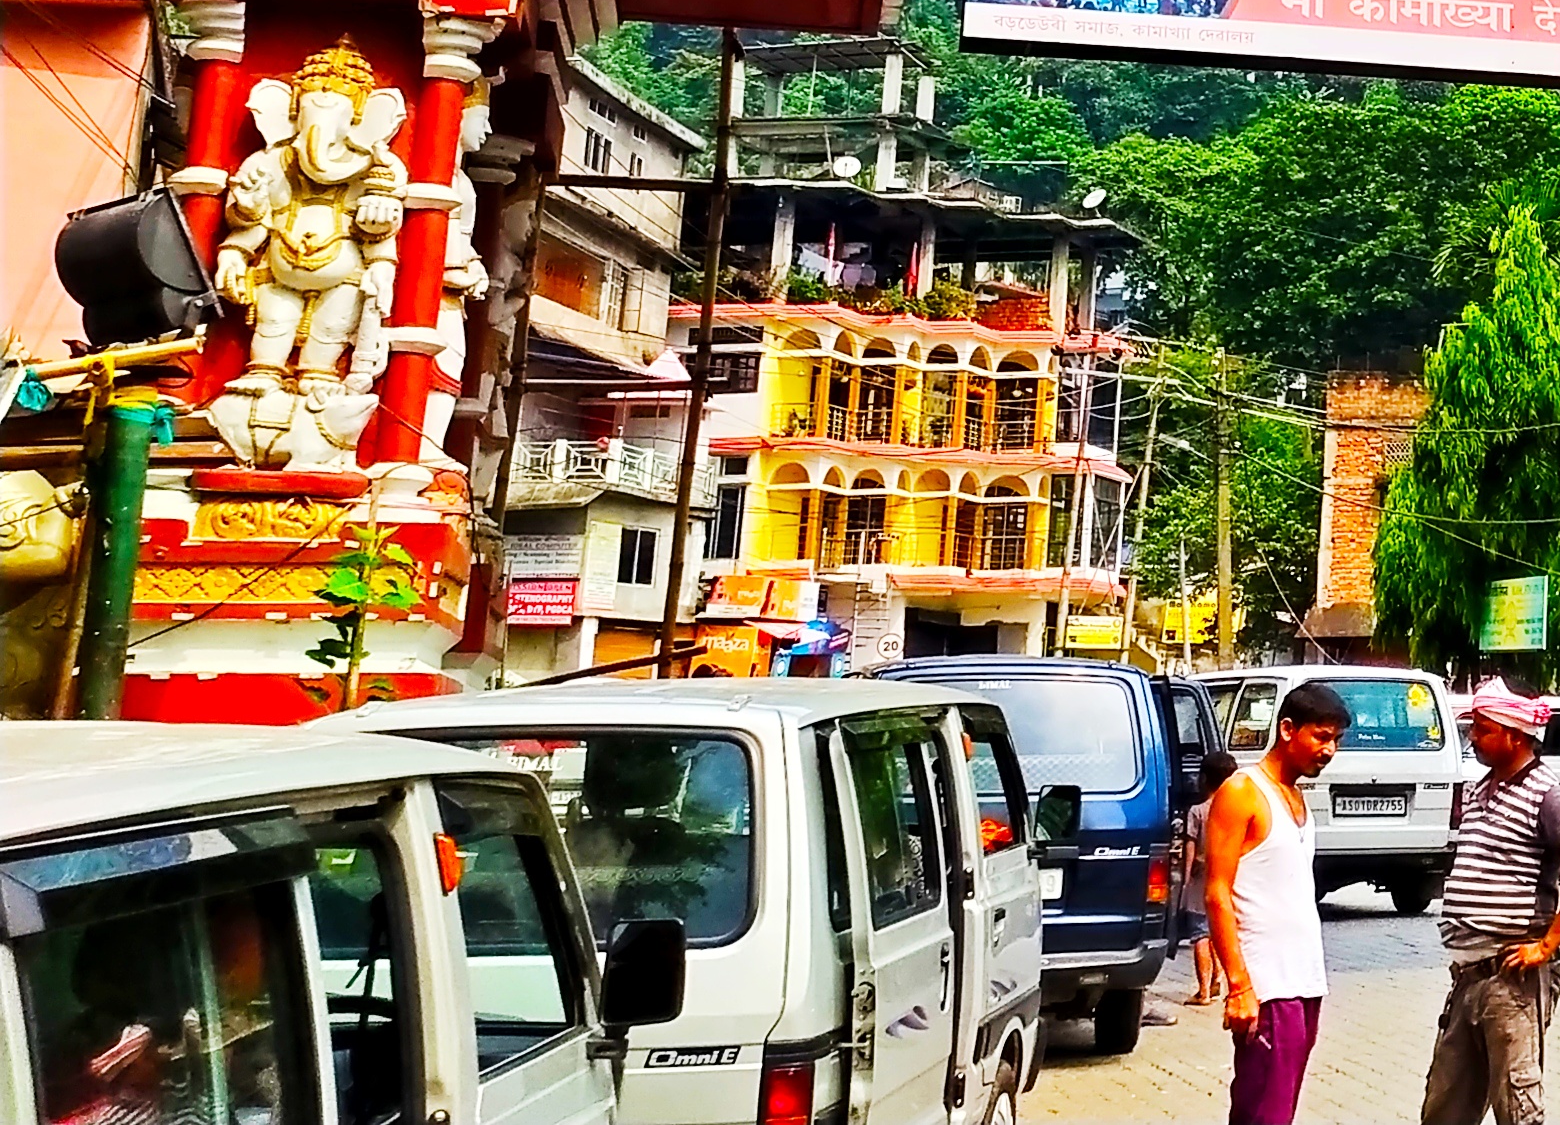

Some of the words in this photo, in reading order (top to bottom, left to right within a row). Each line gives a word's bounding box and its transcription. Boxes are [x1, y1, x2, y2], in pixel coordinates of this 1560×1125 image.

[701, 635, 749, 653] maaza
[883, 641, 899, 652] 20
[1094, 846, 1131, 856] Omni
[648, 1049, 721, 1067] Omni
[720, 1048, 739, 1064] E
